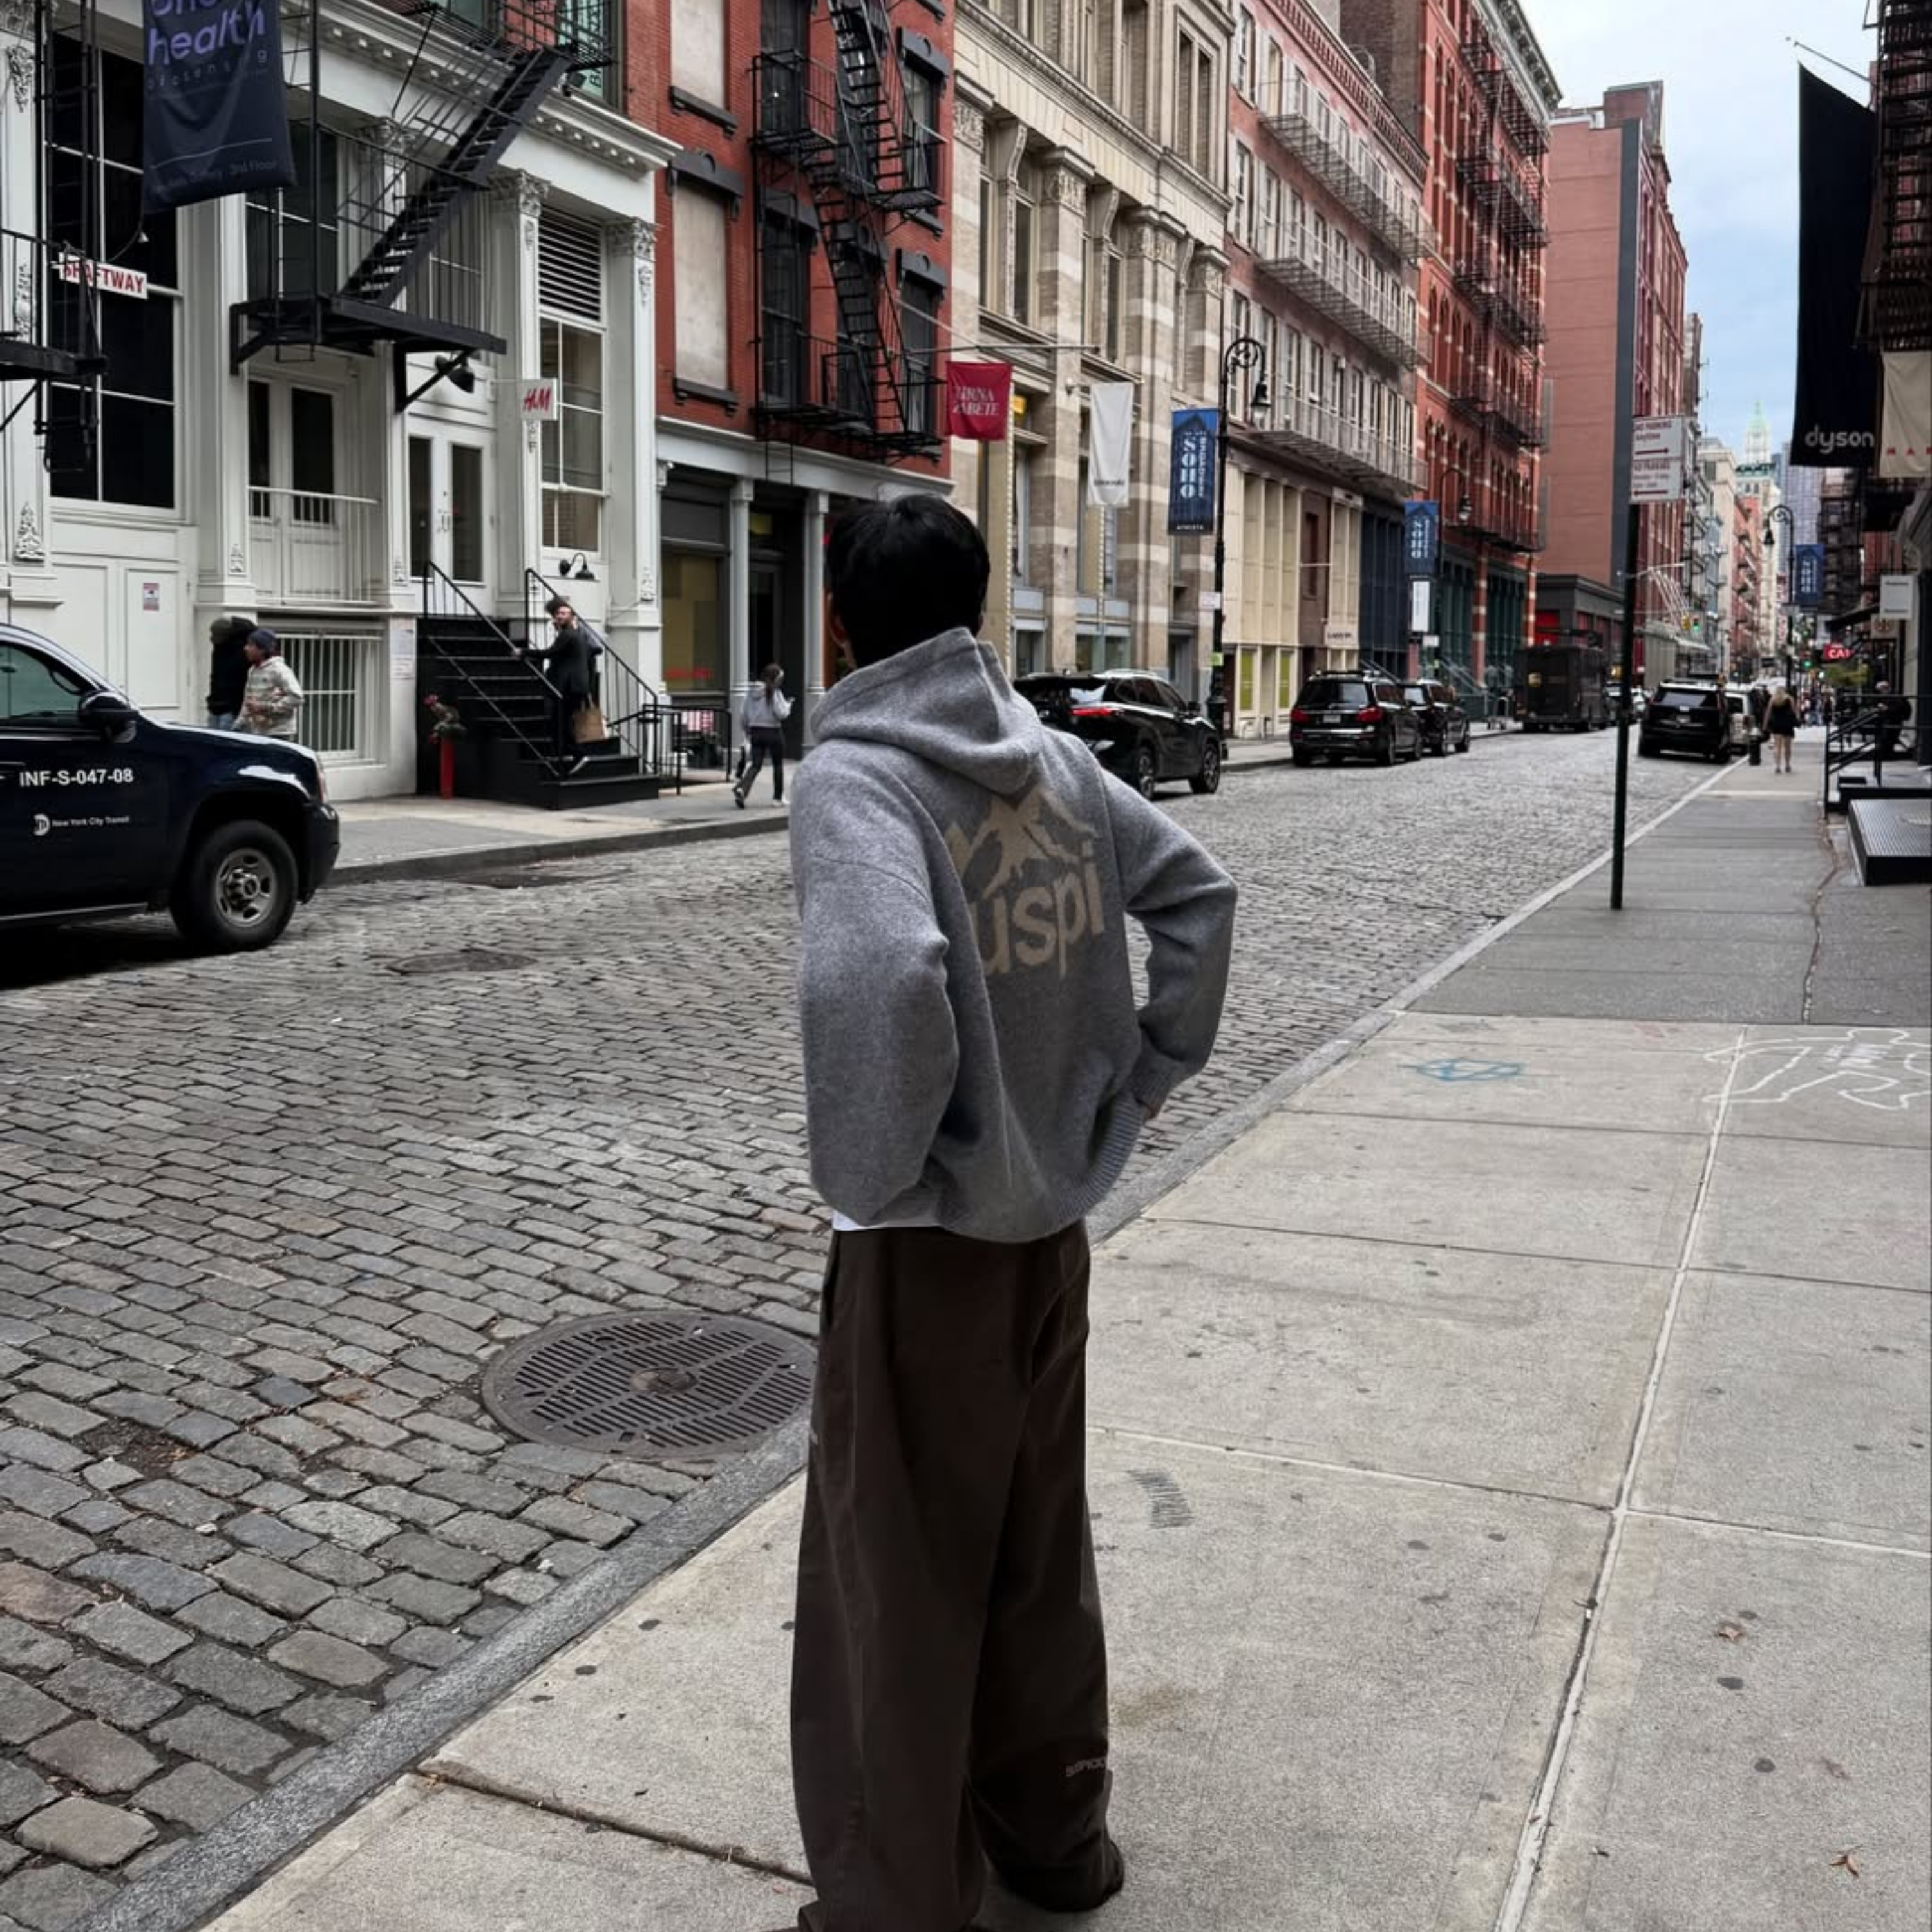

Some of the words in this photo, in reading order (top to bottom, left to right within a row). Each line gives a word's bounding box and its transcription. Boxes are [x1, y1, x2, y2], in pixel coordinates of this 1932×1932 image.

[148, 1, 265, 65] health
[1804, 424, 1875, 455] dyson
[19, 768, 133, 787] INF-S-047-08
[89, 817, 104, 826] City
